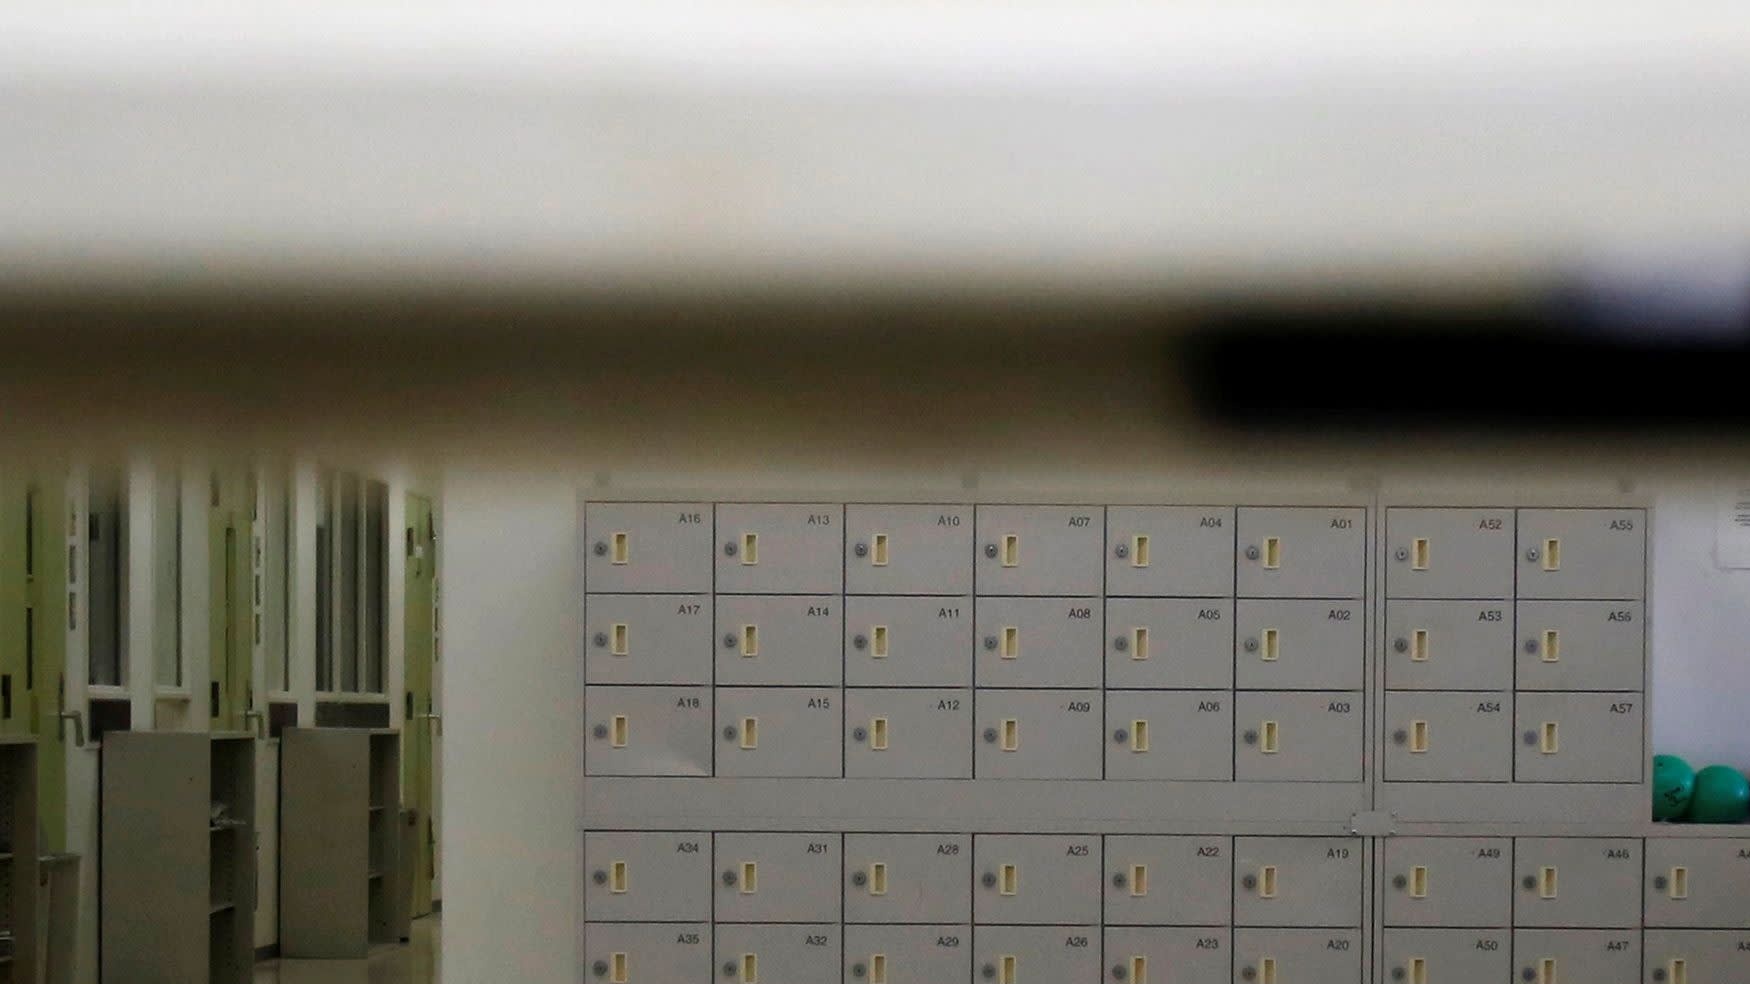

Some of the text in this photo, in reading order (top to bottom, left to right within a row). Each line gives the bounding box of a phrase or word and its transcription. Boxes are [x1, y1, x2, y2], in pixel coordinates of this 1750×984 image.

[678, 512, 702, 524] A16
[807, 514, 830, 526] A13
[937, 514, 960, 527] A10
[1068, 516, 1091, 528] A07
[1199, 516, 1222, 528] A04
[1330, 518, 1353, 529] A01
[1478, 518, 1503, 531] A52
[677, 604, 701, 616] A17
[807, 606, 830, 617] A14
[938, 607, 960, 619] A11
[1068, 607, 1091, 620] A08
[1197, 609, 1221, 621] A05
[1327, 609, 1351, 621] A02
[1478, 610, 1503, 622] A53
[676, 697, 700, 709] A18
[807, 697, 830, 710] A15
[937, 699, 960, 711] A12
[1067, 701, 1091, 713] A09
[1197, 700, 1221, 713] A06
[1327, 702, 1351, 714] A03
[1476, 702, 1501, 713] A54
[1609, 702, 1633, 714] A57
[676, 842, 699, 854] A34
[807, 843, 828, 854] A31
[936, 844, 960, 856] A28
[1066, 844, 1089, 857] A25
[1196, 846, 1220, 857] A22
[1326, 847, 1350, 860] A19
[1477, 848, 1501, 859] A49
[676, 933, 700, 945] A35
[805, 935, 828, 947] A32
[936, 936, 960, 948] A29
[1065, 936, 1088, 948] A26
[1195, 938, 1219, 950] A23
[1326, 939, 1350, 951] A20
[1475, 939, 1499, 952] A50
[1606, 940, 1630, 952] A47
